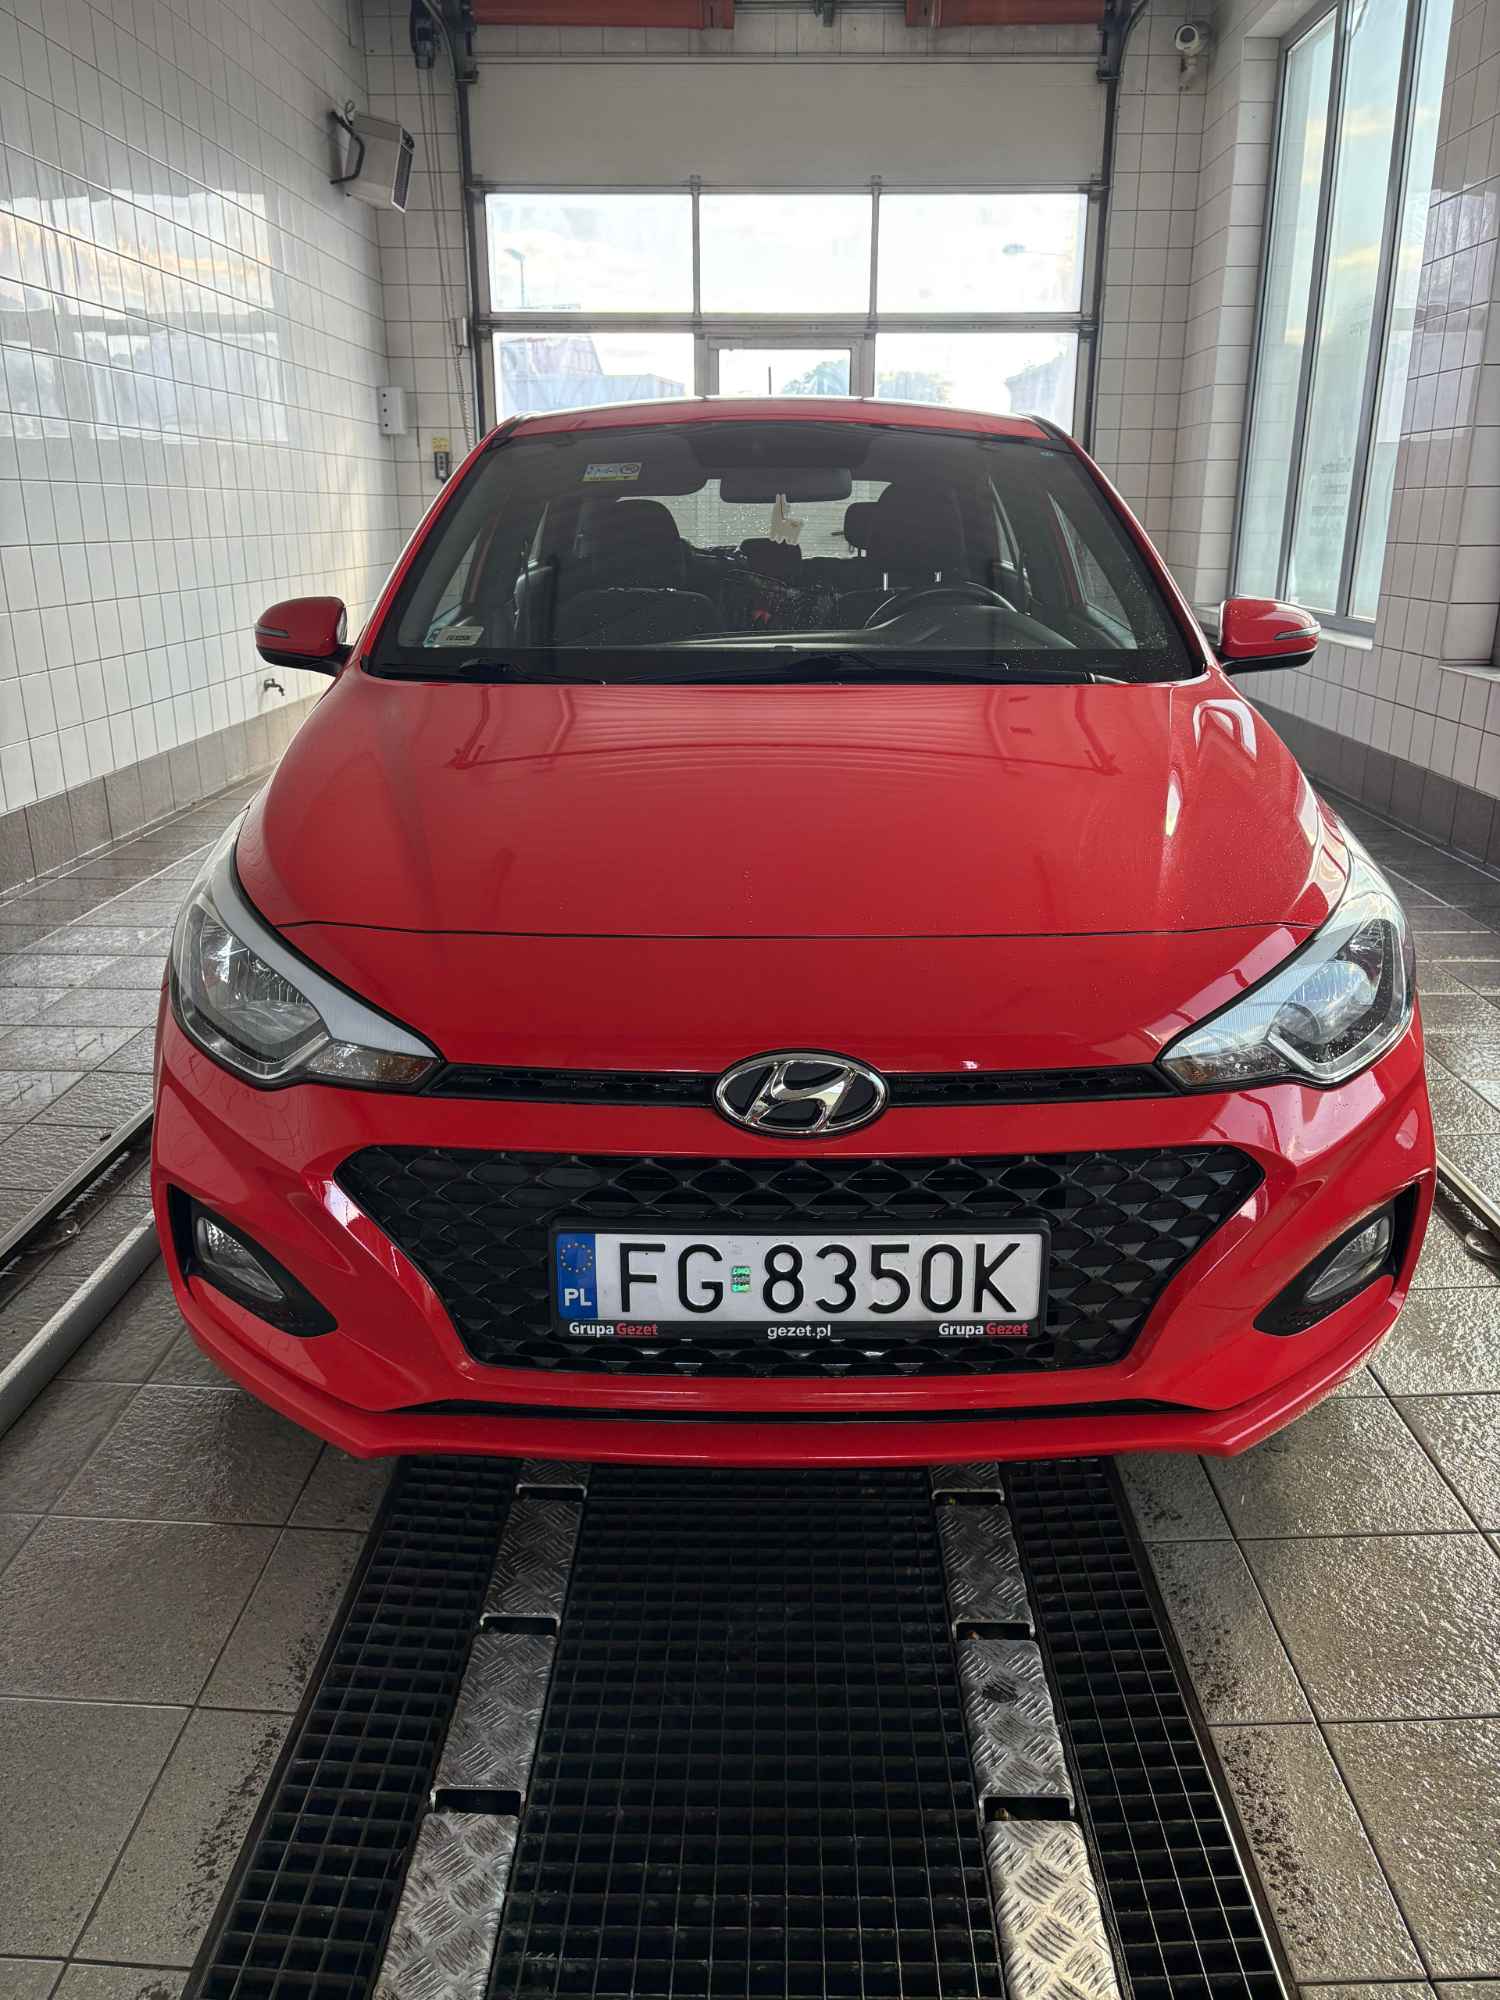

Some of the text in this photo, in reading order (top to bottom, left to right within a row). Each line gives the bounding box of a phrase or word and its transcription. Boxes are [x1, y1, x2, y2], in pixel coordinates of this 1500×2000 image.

[619, 1241, 1021, 1314] FG 8350K
[565, 1289, 592, 1307] PL
[569, 1322, 658, 1338] Grupa Gezet
[767, 1323, 832, 1340] gezet.pl
[938, 1322, 1029, 1338] Grupa Gezet
